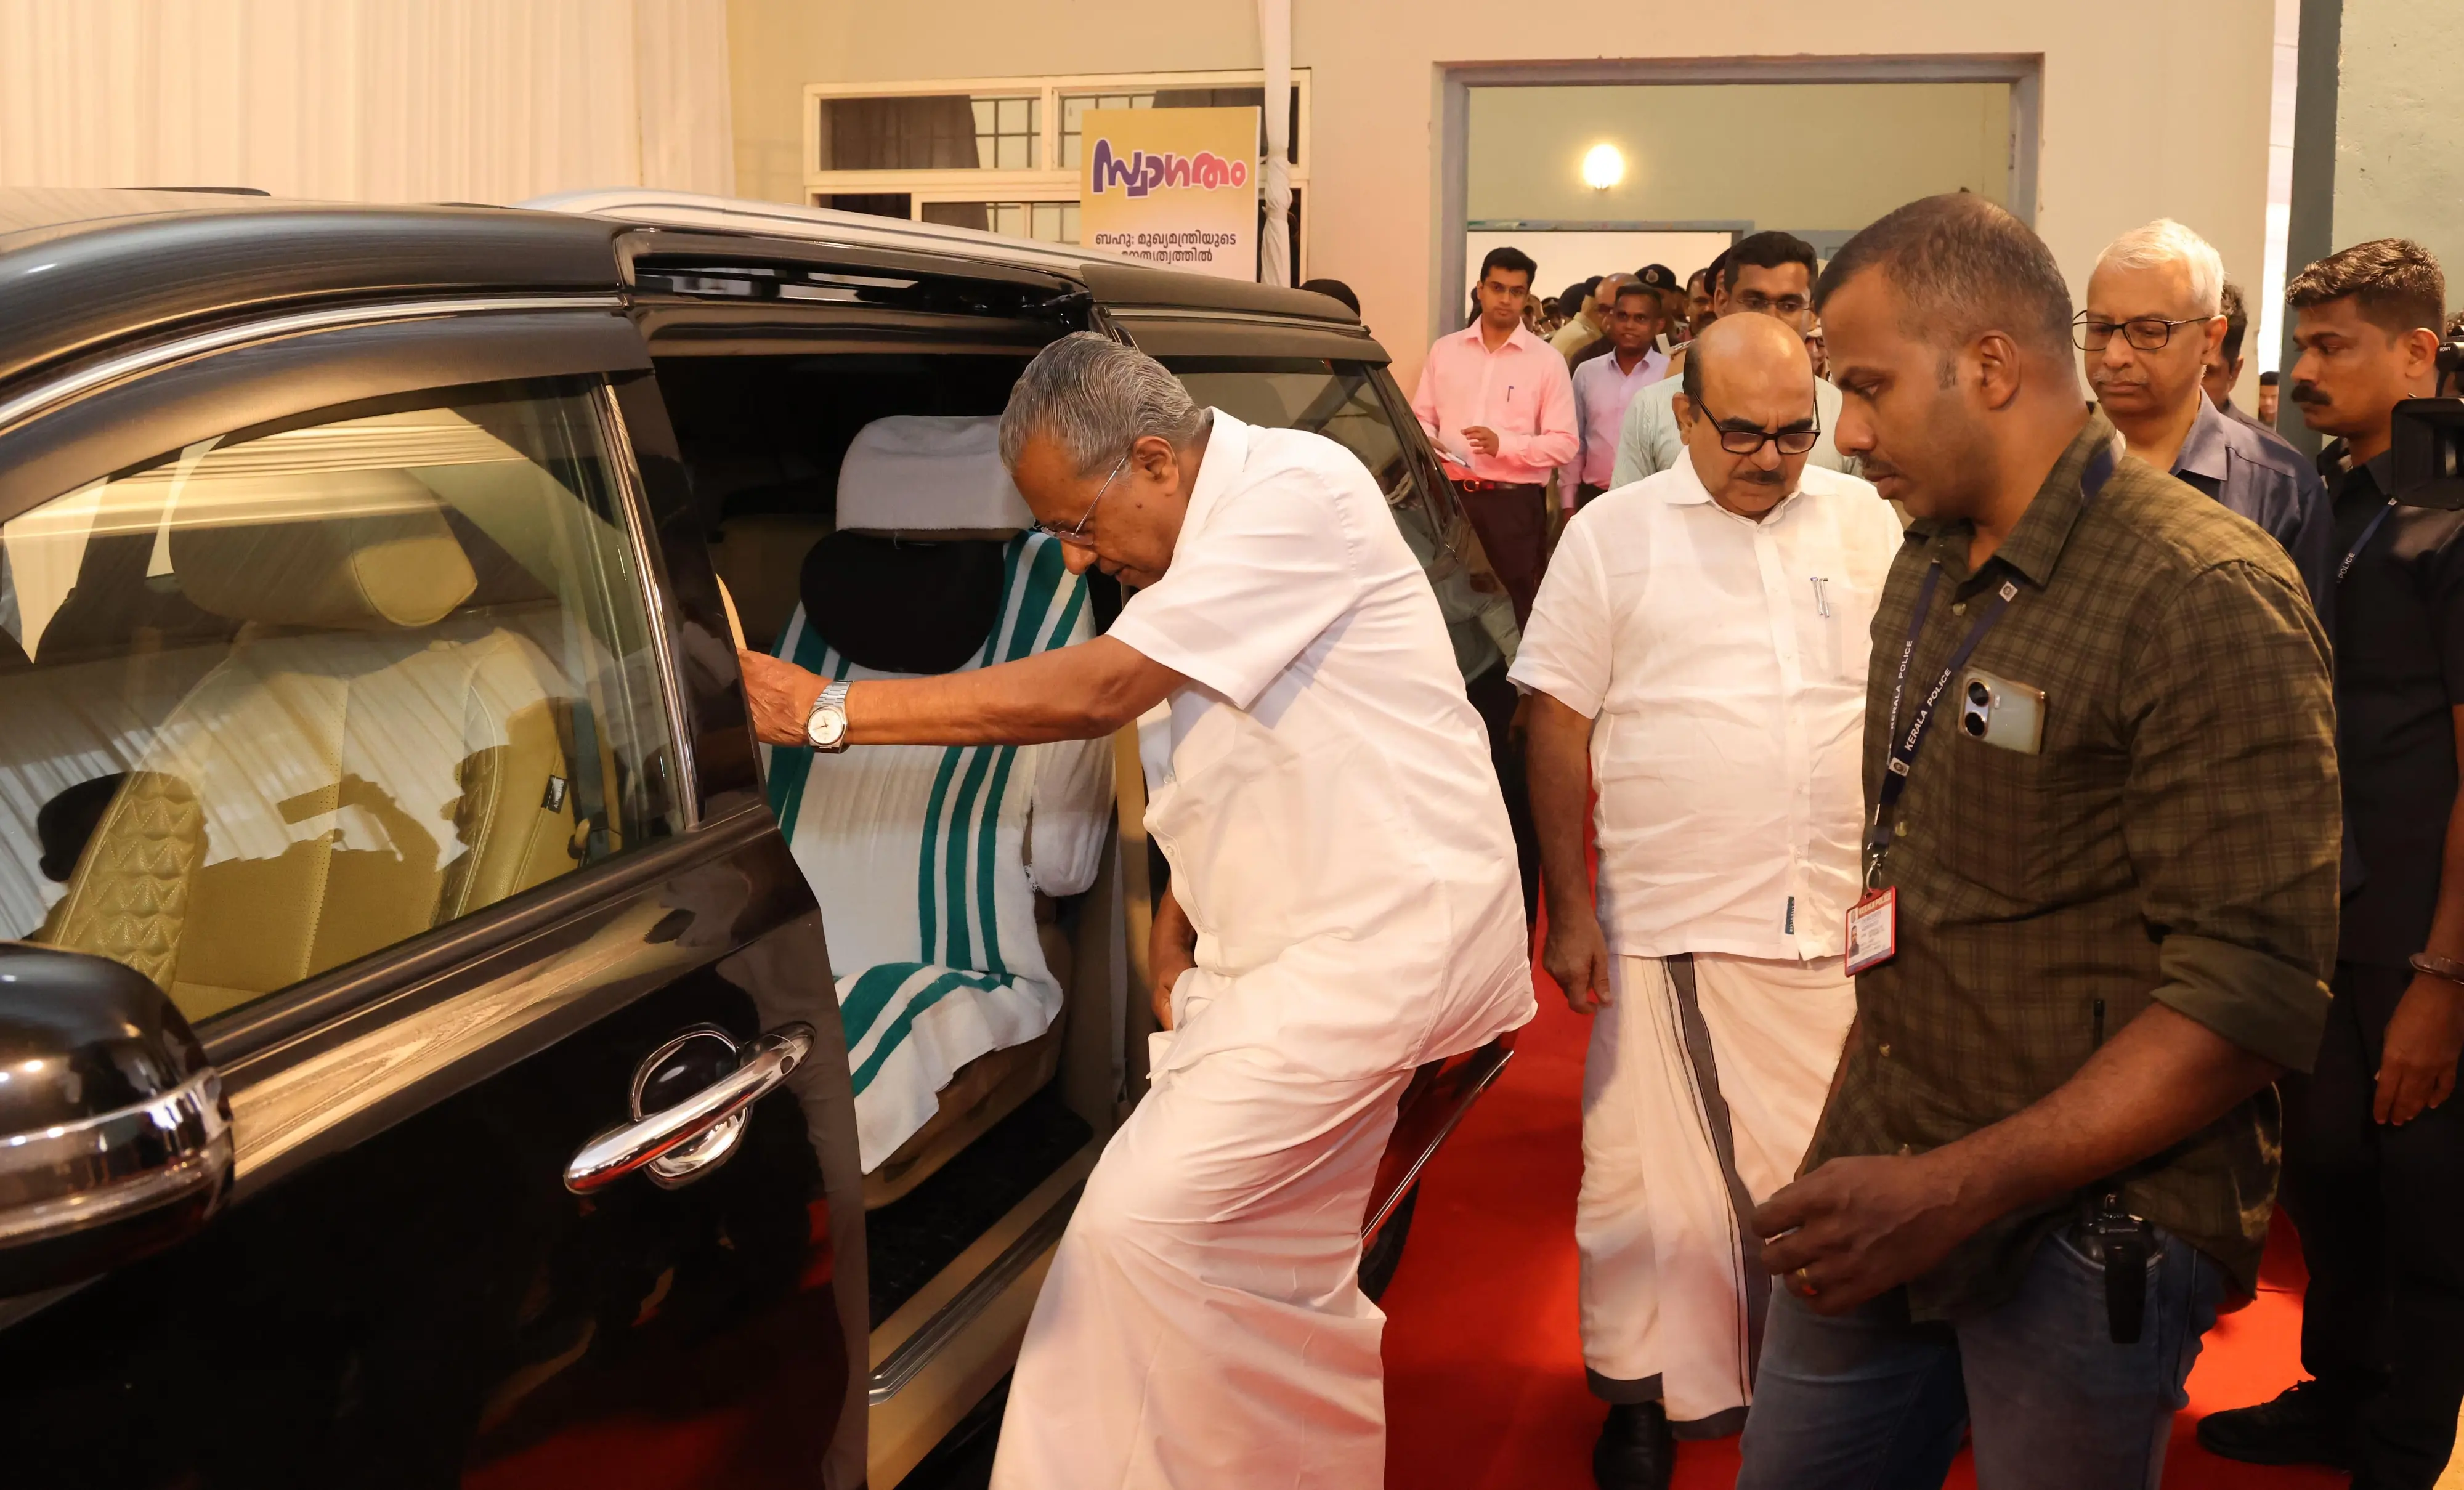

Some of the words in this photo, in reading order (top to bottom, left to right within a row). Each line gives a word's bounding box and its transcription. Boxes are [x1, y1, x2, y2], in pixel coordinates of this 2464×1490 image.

[1092, 139, 1247, 198] സ്വാഗതം
[1095, 233, 1134, 248] ബഹു:
[1138, 229, 1236, 248] മുഖ്യമന്ത്രിയുടെ
[2338, 552, 2356, 579] POLICE
[1890, 684, 1902, 729] KERALA
[1898, 641, 1913, 679] POLICE
[1904, 710, 1928, 751] KERALA
[1927, 668, 1951, 707] POLICE
